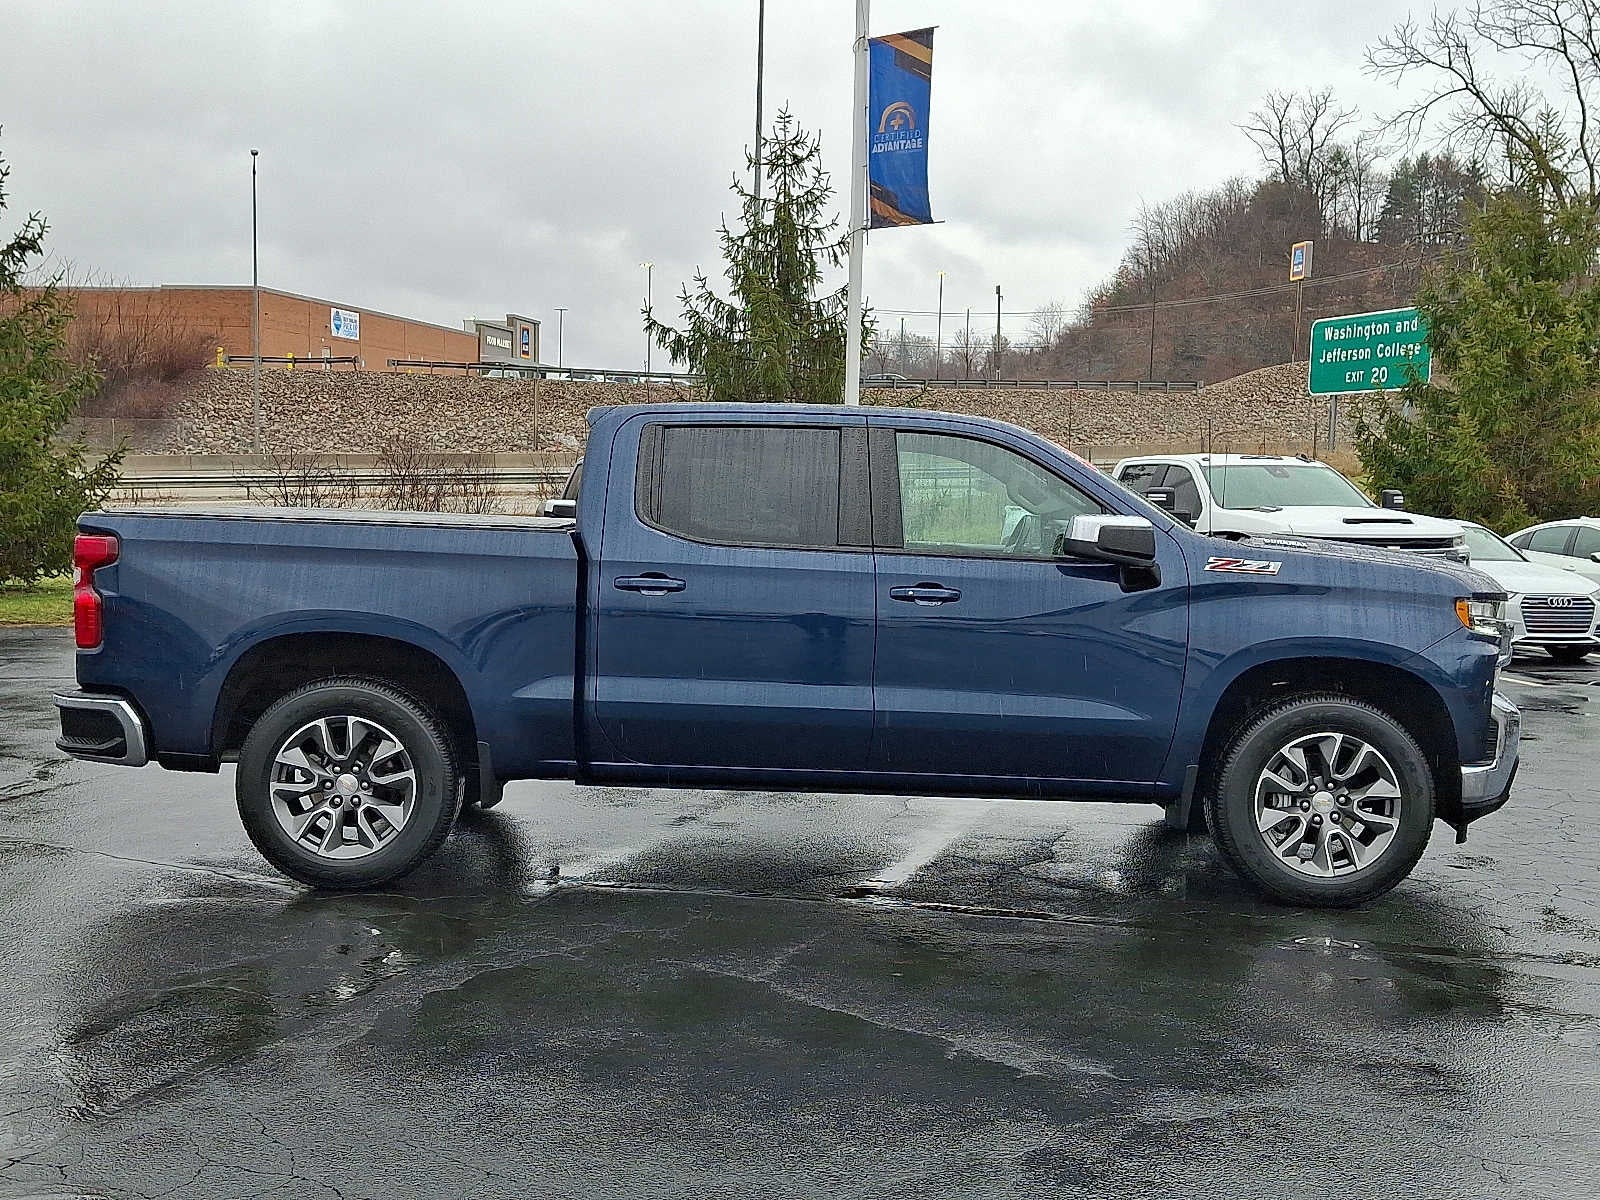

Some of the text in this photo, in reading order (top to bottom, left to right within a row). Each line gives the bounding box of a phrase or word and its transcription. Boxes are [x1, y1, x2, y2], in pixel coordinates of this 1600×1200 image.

[874, 130, 921, 143] CERTIFIED
[872, 138, 922, 154] ADVANTAGE
[1325, 316, 1418, 341] Washington and
[486, 336, 496, 346] FOOD
[1320, 342, 1421, 364] Jefferson College
[1345, 367, 1388, 383] EXIT 20
